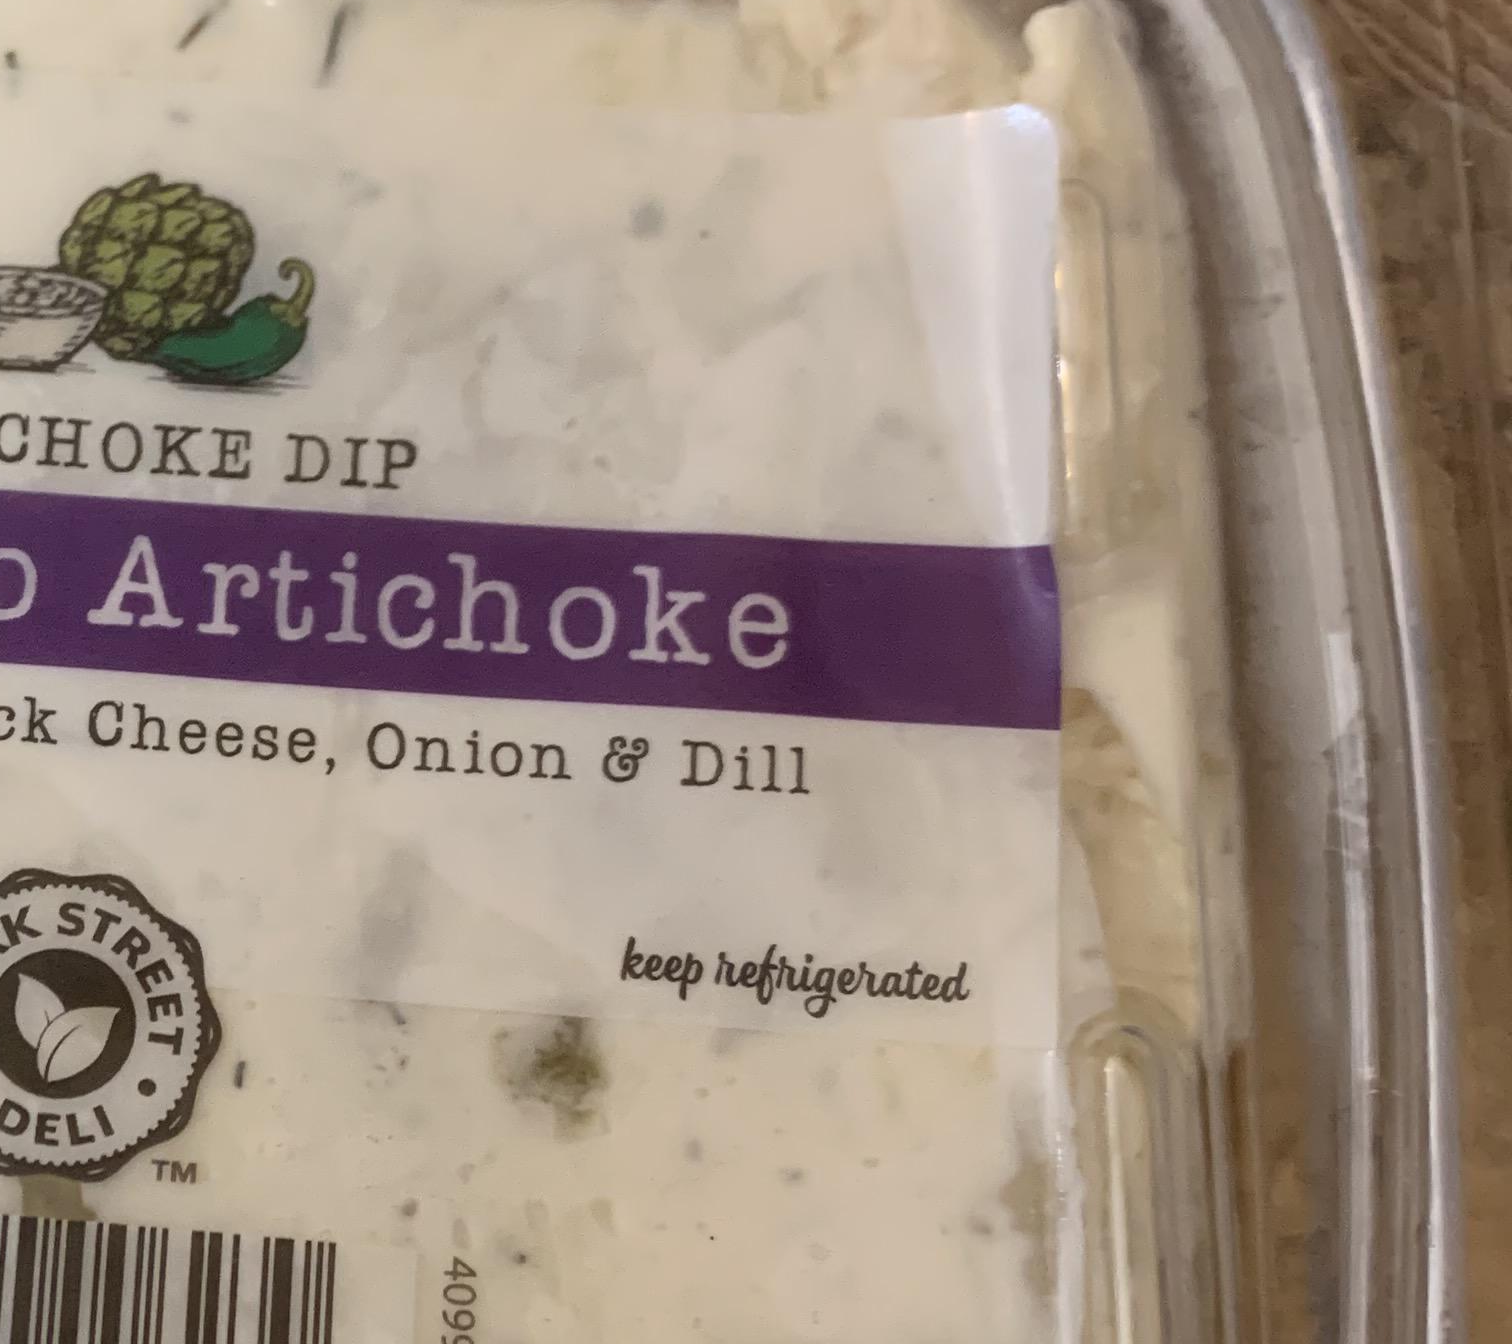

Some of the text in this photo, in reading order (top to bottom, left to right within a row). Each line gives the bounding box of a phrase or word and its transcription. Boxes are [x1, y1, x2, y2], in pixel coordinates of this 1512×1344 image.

[284, 432, 420, 490] DIP
[88, 533, 791, 669] Artichoke
[87, 699, 338, 776] Cheese,
[365, 722, 571, 780] Onion
[601, 736, 648, 783] &
[680, 740, 812, 795] Dill
[56, 902, 185, 1056] STREET
[620, 936, 969, 1018] keep refrigerated
[151, 1159, 198, 1185] TM
